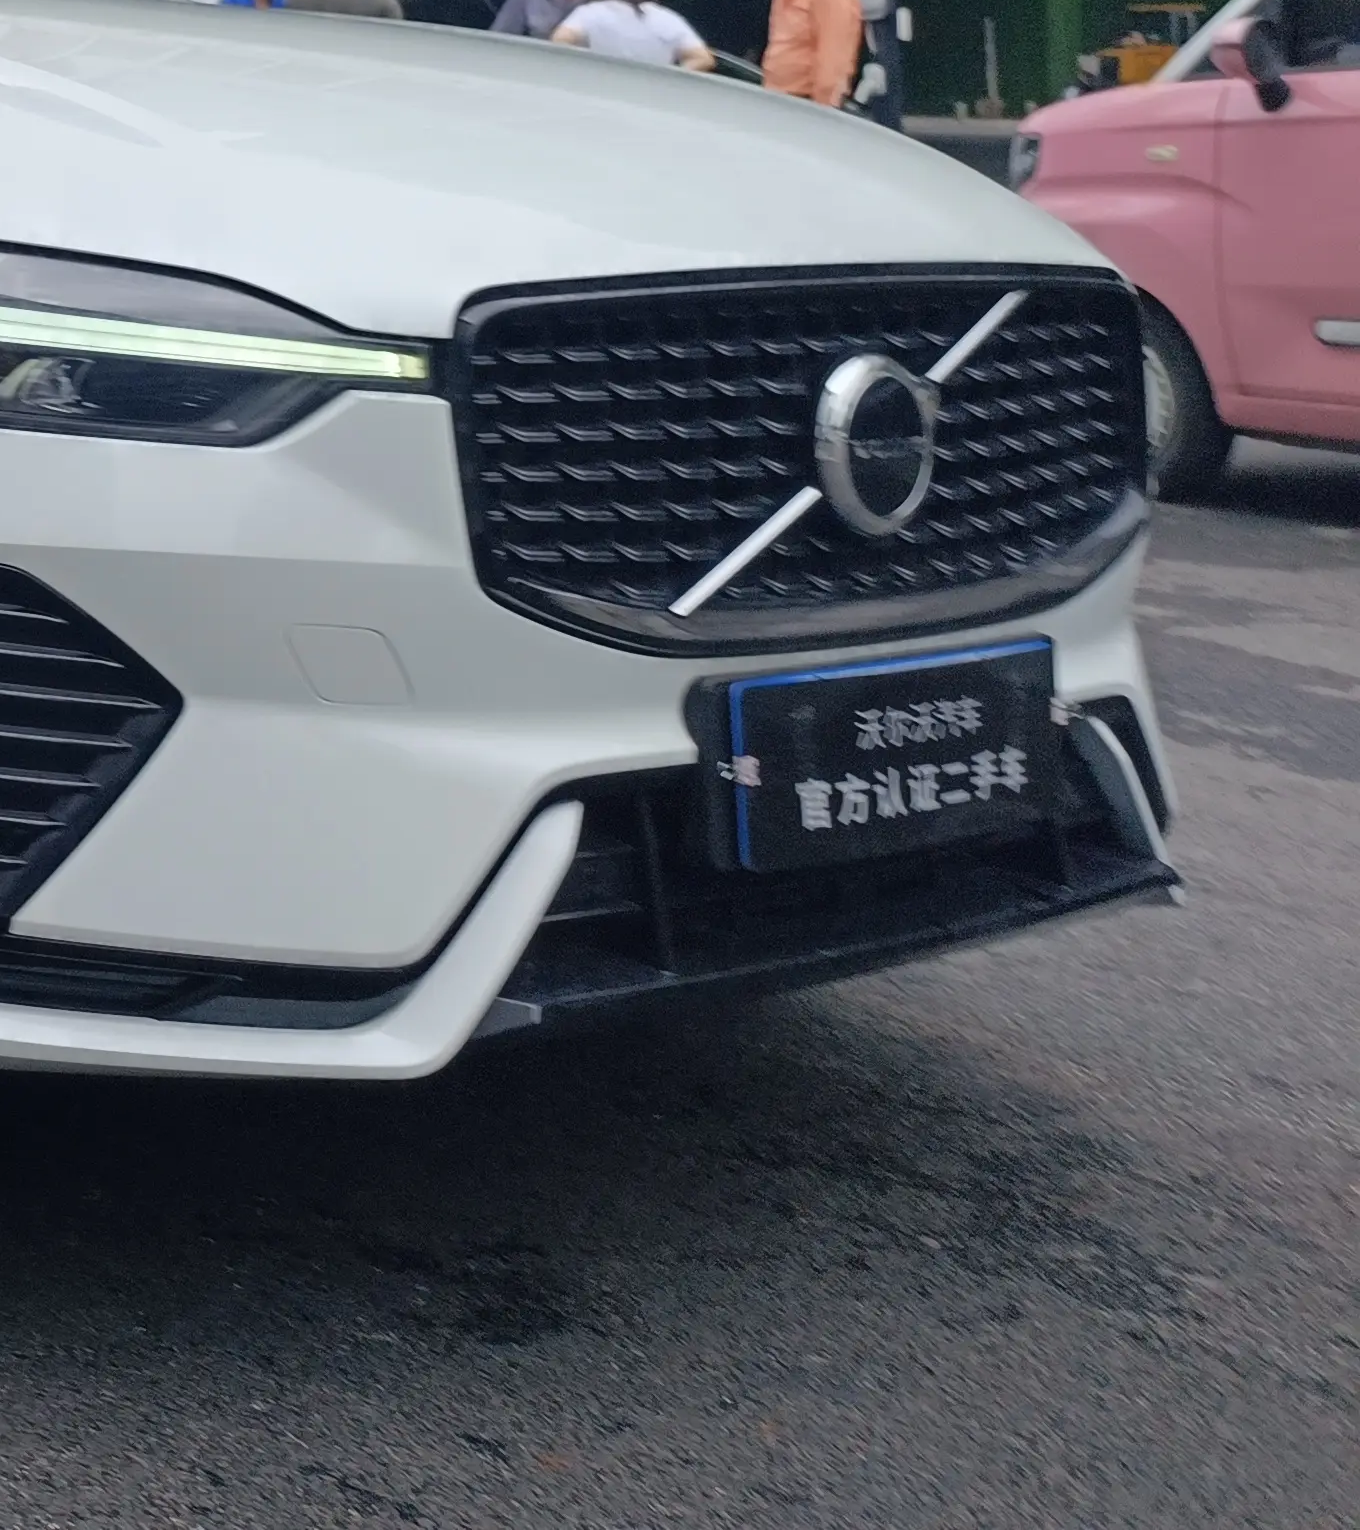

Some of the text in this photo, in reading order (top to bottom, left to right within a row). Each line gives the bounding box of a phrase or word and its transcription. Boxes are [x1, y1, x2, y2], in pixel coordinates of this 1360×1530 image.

[794, 744, 1029, 831] 官方认证二手车
